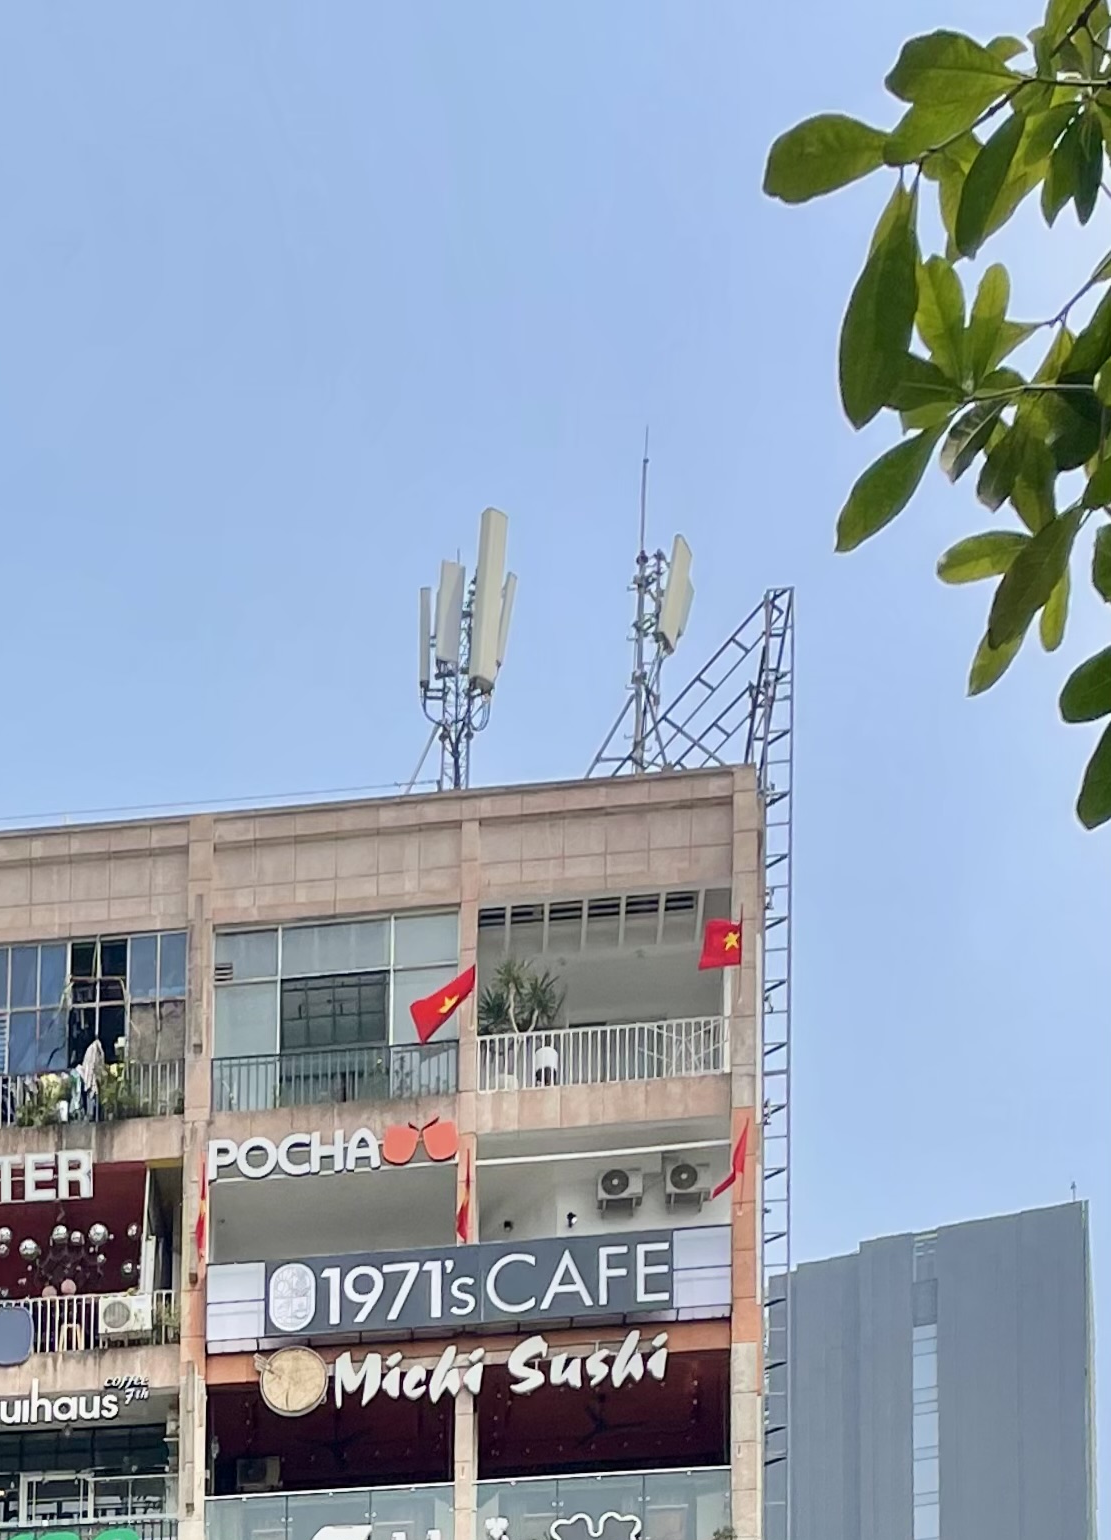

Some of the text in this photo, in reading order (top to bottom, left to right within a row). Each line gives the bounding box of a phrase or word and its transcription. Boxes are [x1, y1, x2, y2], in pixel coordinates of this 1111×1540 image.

[208, 1127, 381, 1181] POCHA
[320, 1242, 671, 1325] 1971's CAFE
[103, 1376, 149, 1390] coffee
[124, 1387, 150, 1405] 7th
[335, 1330, 669, 1408] Michi Sushi
